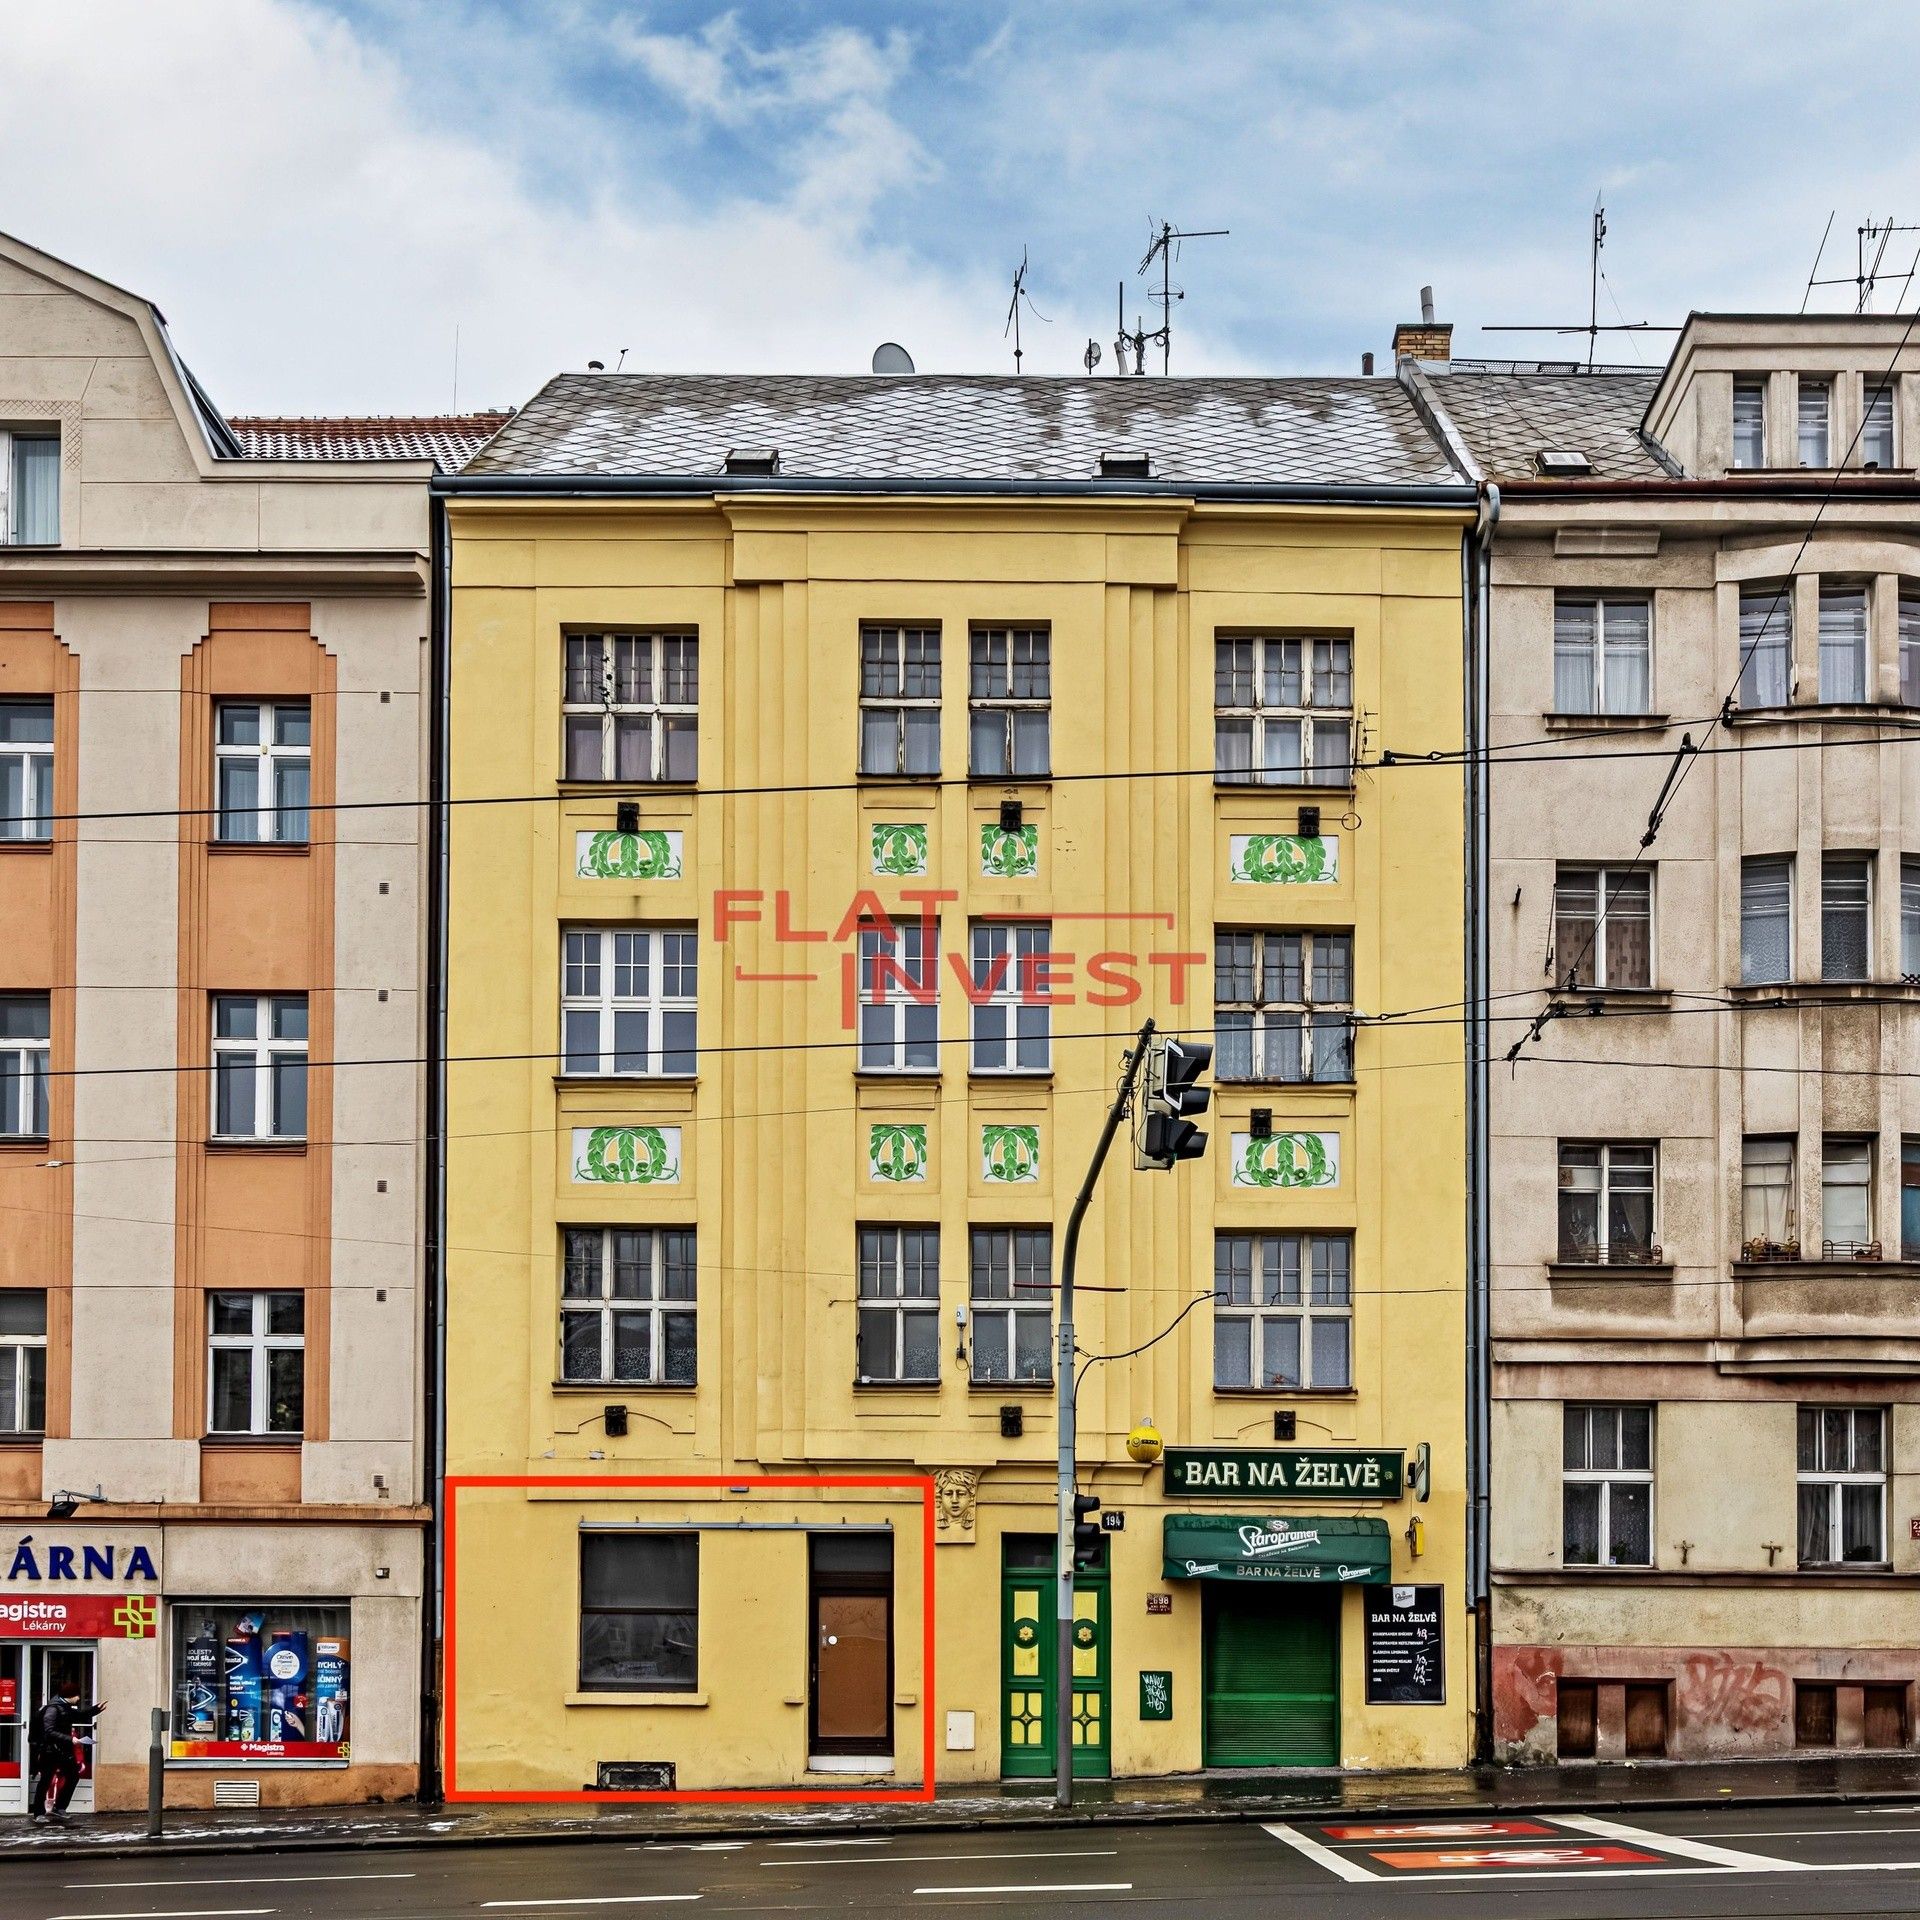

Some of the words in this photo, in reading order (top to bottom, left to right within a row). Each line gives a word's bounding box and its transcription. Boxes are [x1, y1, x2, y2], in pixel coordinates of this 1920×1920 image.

[1185, 1461, 1240, 1487] BAR
[1248, 1461, 1287, 1487] NA
[1295, 1457, 1381, 1488] ŽELVĚ
[1106, 1515, 1121, 1526] 194
[1913, 1521, 1920, 1529] 2
[1238, 1525, 1321, 1557] Staropramen
[0, 1535, 158, 1580] ÁRNA
[1237, 1565, 1261, 1577] BAR
[1264, 1566, 1282, 1577] NA
[1284, 1565, 1321, 1578] ŽELVĚ
[1372, 1613, 1391, 1623] BAR
[1392, 1613, 1406, 1623] NA
[1408, 1611, 1437, 1623] ŽELVĚ
[23, 1621, 66, 1632] Lékárny
[249, 1743, 285, 1752] Magistra
